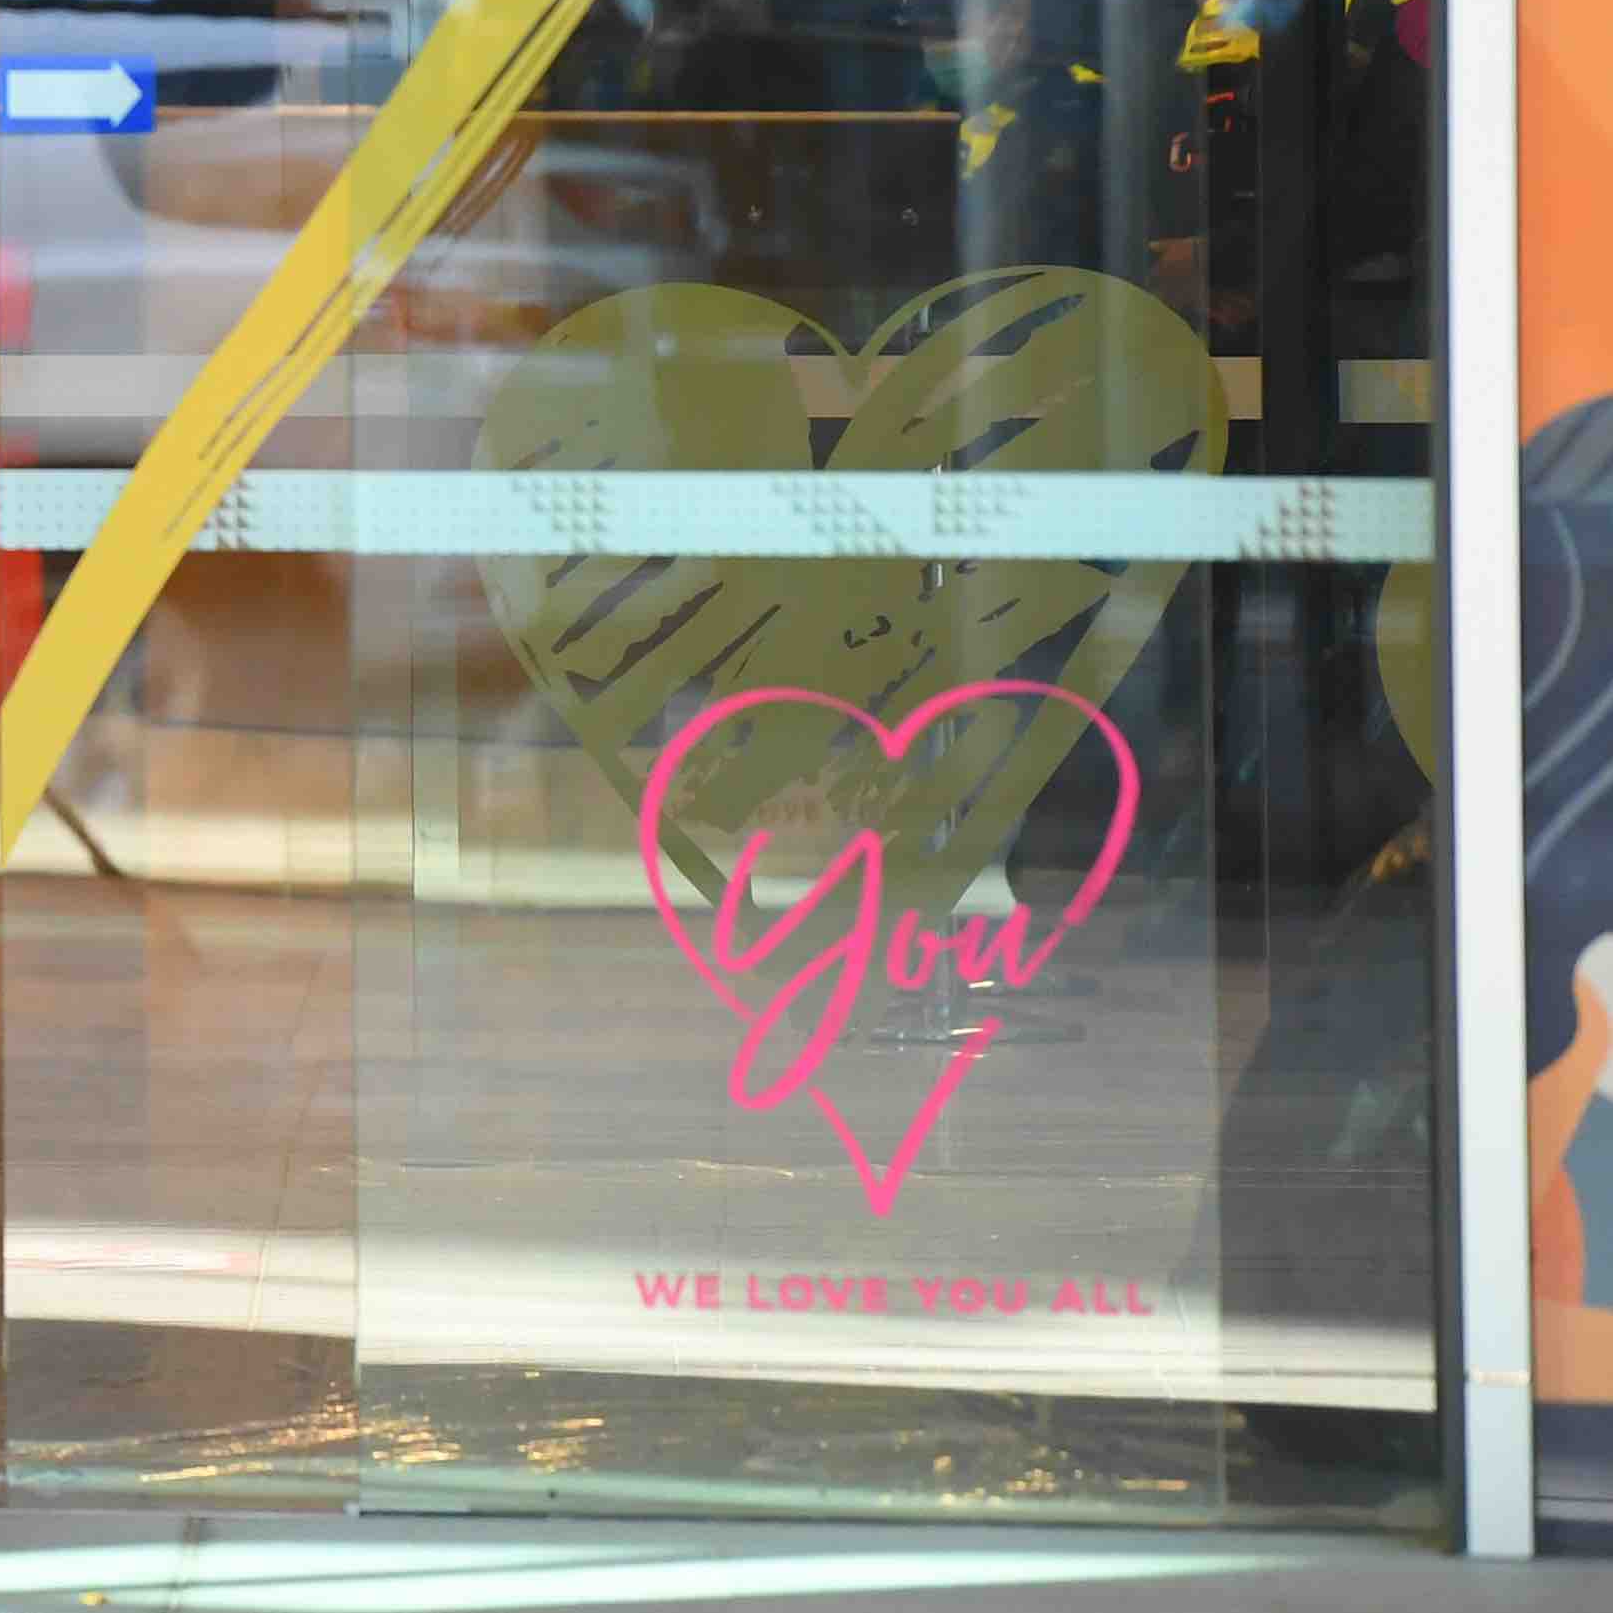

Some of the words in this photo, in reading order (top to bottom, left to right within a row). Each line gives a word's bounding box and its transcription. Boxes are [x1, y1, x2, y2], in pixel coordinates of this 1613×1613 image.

[713, 828, 1063, 1111] You
[636, 1273, 719, 1309] WE
[749, 1274, 887, 1311] LOVE
[911, 1277, 1027, 1314] YOU
[1049, 1279, 1152, 1316] ALL
